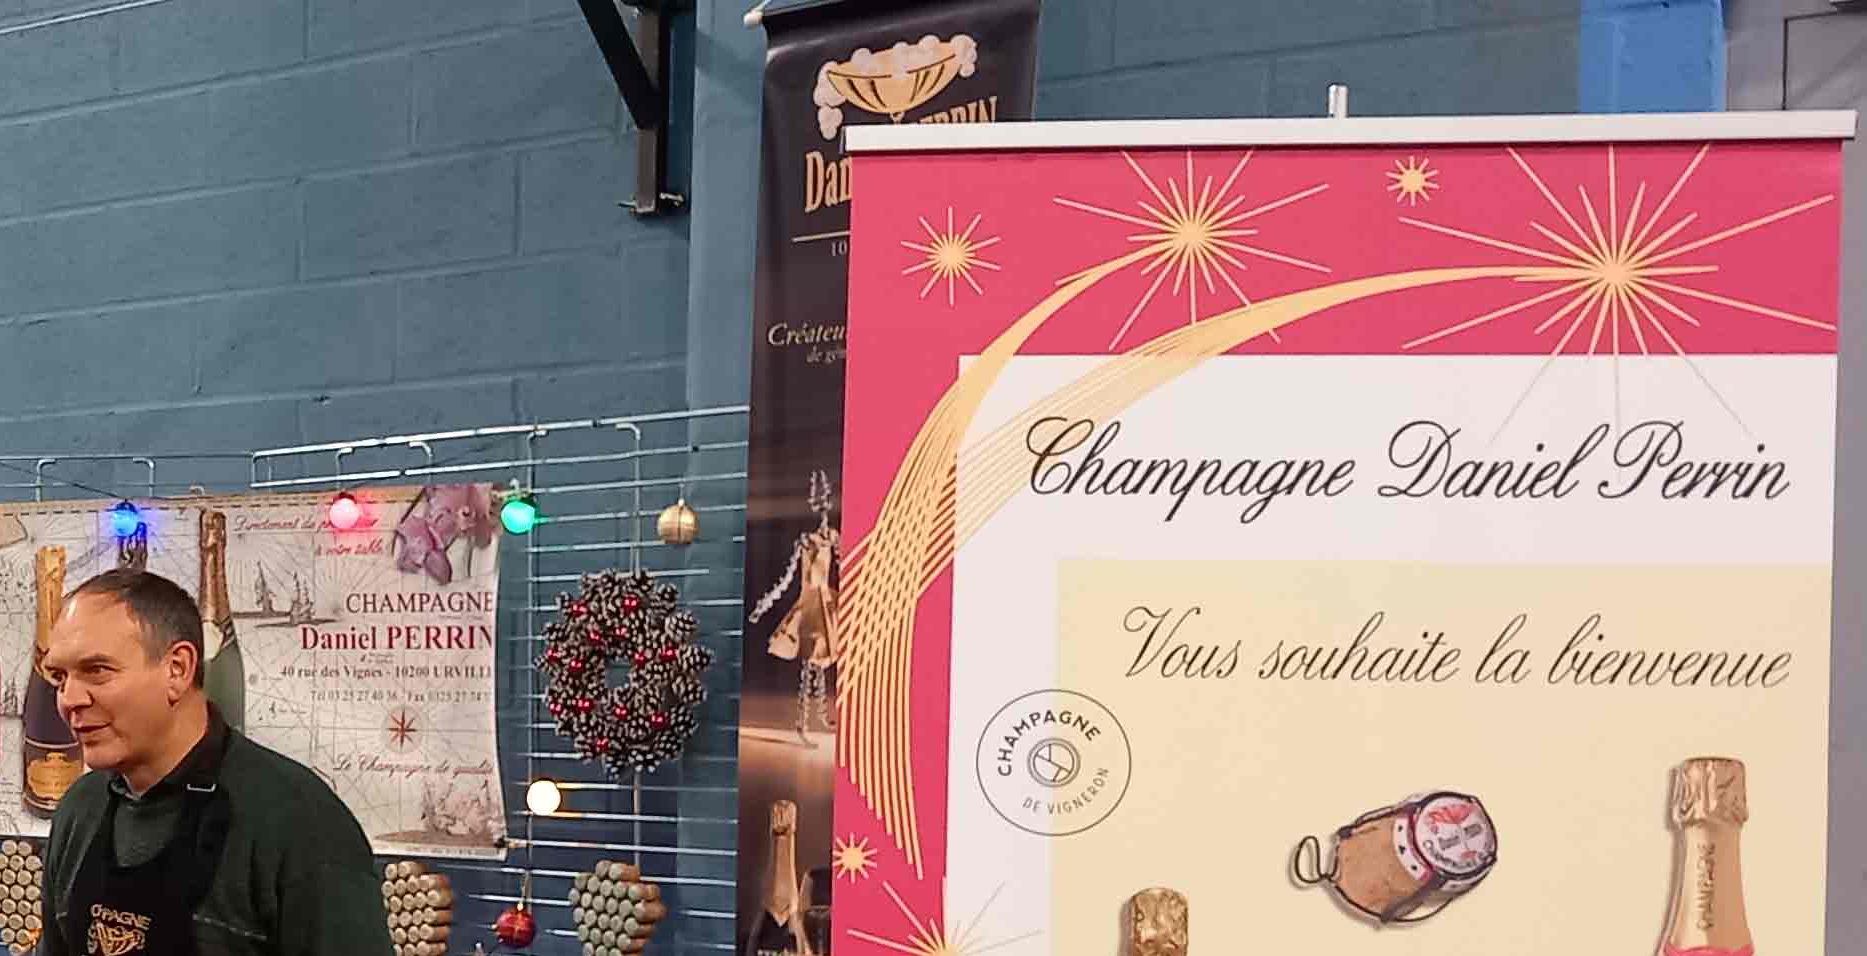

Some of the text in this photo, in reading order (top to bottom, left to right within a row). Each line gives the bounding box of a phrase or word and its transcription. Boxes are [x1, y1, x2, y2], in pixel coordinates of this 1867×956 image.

[805, 150, 852, 212] Dan
[768, 323, 847, 345] Créateu
[1026, 416, 1791, 524] Champagne Daniel Perrin
[345, 590, 495, 614] CHAMPAGNE
[301, 624, 494, 652] Daniel PERRIN
[1123, 606, 1793, 688] Vous souhaite la bienvenue
[281, 665, 294, 678] 40
[298, 666, 317, 679] rue
[320, 664, 340, 678] des
[343, 664, 382, 681] Vignes
[395, 665, 429, 679] 10200
[433, 665, 493, 680] URVILL
[997, 709, 1101, 777] CHAMPAGNE
[1022, 767, 1109, 815] DE VIGNERON
